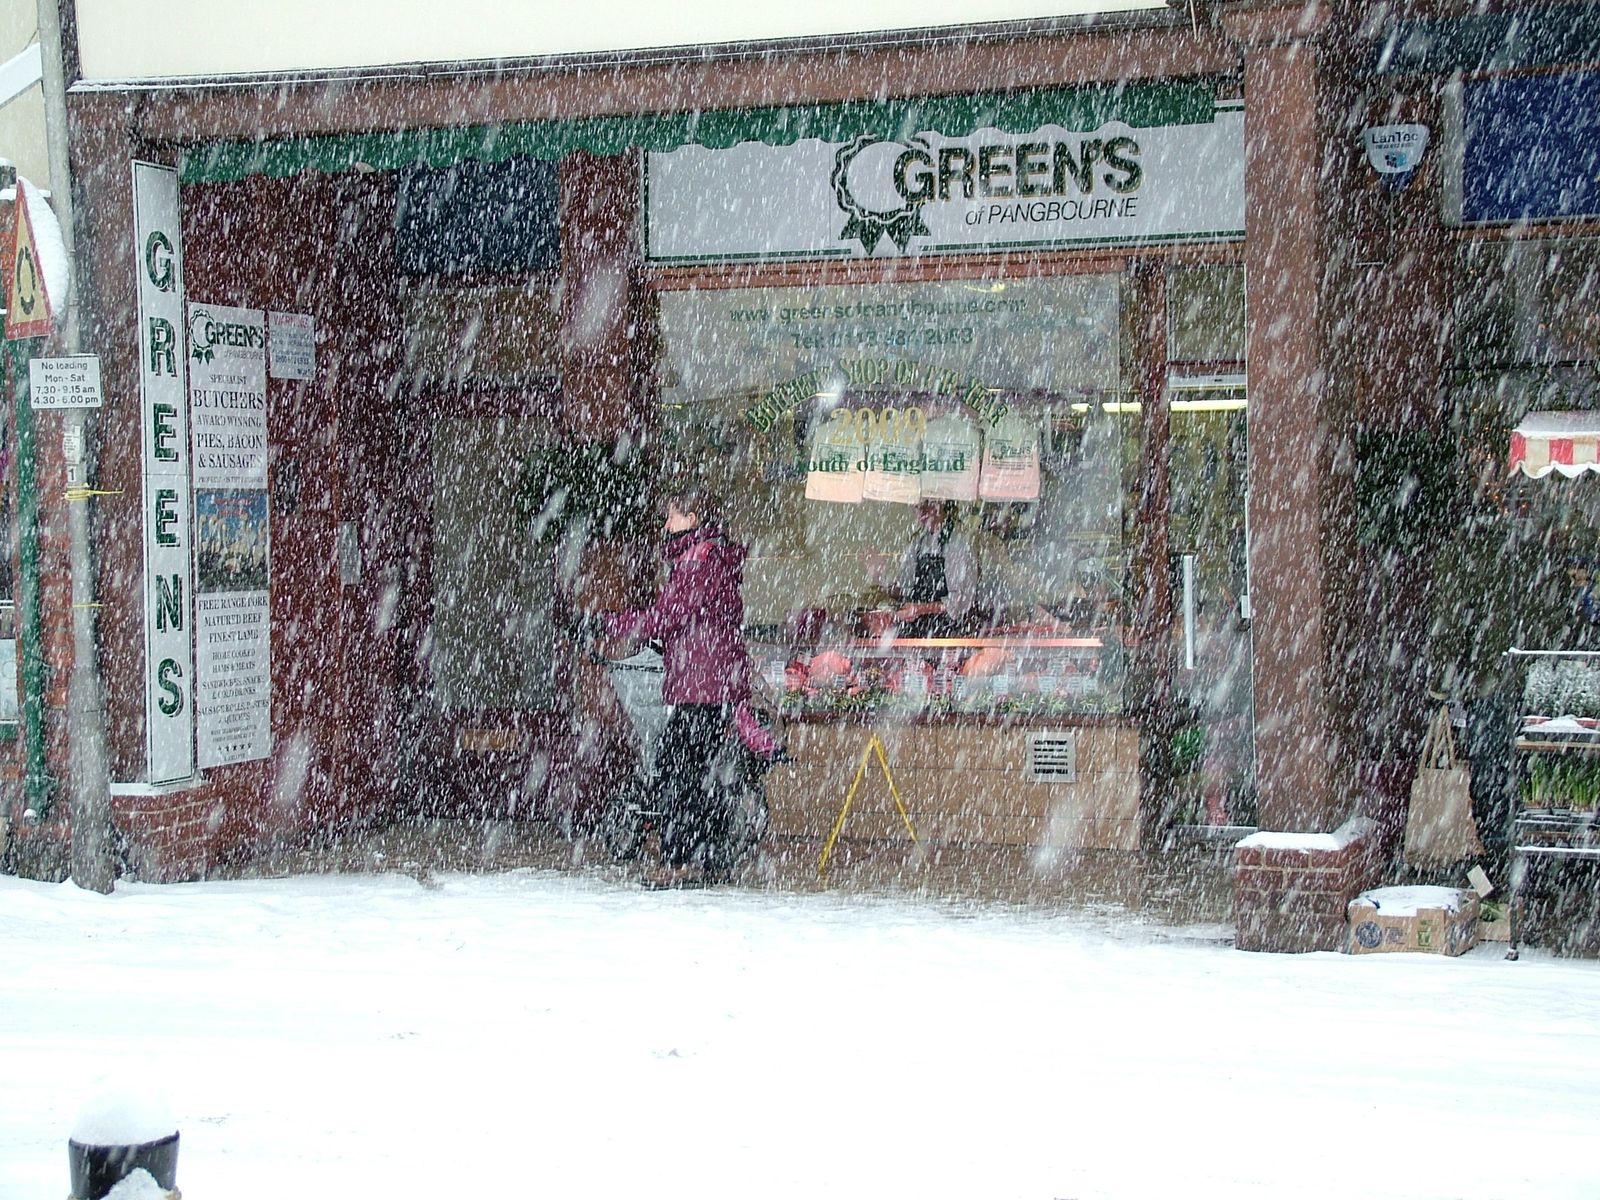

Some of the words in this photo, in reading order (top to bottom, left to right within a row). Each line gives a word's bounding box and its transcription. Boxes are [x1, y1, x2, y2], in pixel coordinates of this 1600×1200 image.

[1372, 132, 1418, 144] LanTec
[893, 136, 1142, 203] GREEN'S
[966, 204, 983, 225] of
[988, 197, 1139, 224] PANGBOURNE
[42, 362, 54, 370] No
[56, 362, 88, 370] loading
[45, 374, 64, 382] Mon
[70, 374, 86, 382] Sat
[36, 386, 56, 394] 7.30
[62, 386, 80, 394] 9.15
[34, 396, 56, 404] 4.30
[85, 396, 99, 404] pm
[193, 388, 264, 411] BUTCHERS
[227, 415, 262, 428] WINNING
[830, 406, 927, 446] 2009
[196, 432, 225, 450] PIES,
[228, 433, 262, 450] BACON
[198, 453, 206, 468] &
[208, 453, 263, 469] SAUSAGES
[882, 452, 965, 475] England
[68, 468, 74, 481] 1
[146, 230, 183, 719] GREENS
[198, 599, 220, 611] FREE
[209, 631, 236, 644] FINEST
